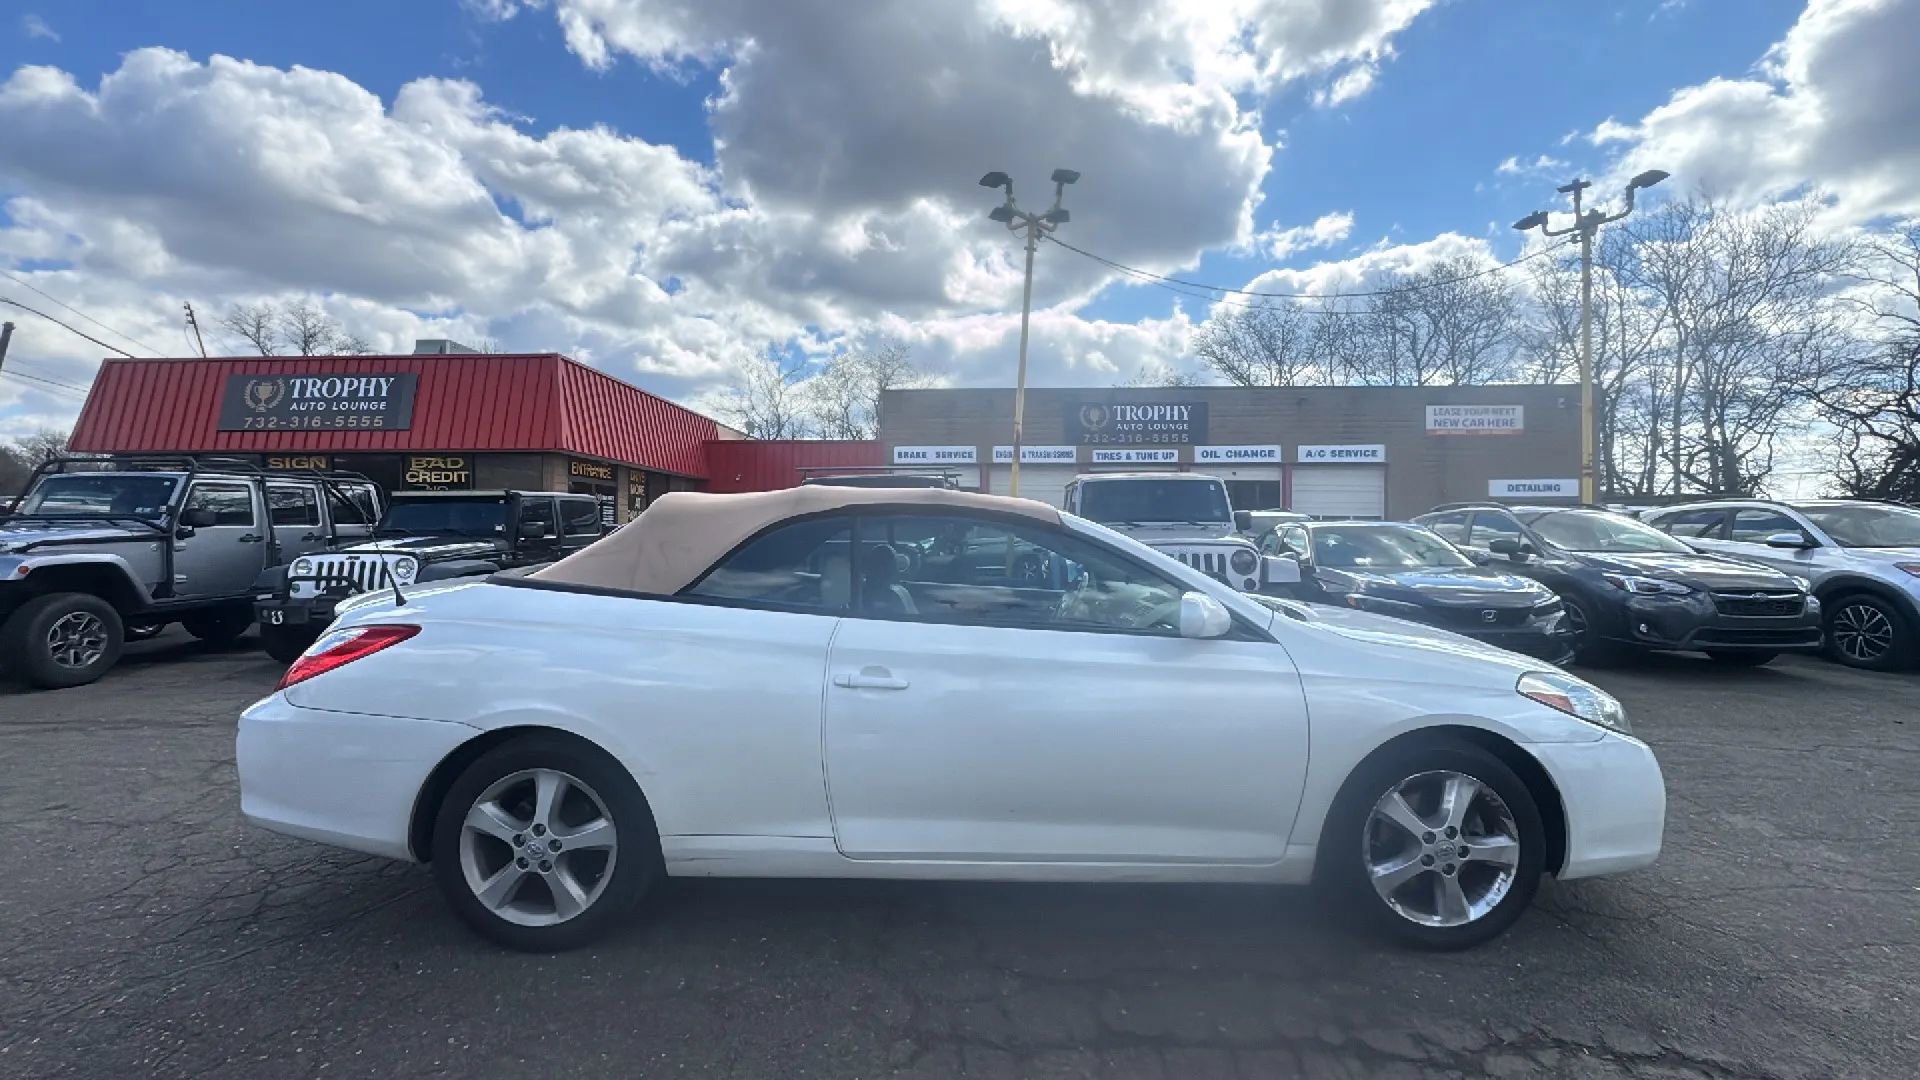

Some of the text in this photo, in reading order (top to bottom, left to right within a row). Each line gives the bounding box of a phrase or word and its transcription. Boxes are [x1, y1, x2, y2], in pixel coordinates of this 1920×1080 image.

[290, 377, 394, 398] TROPHY
[290, 401, 387, 411] AUTO LOUNGE
[1113, 405, 1192, 421] TROPHY
[1433, 407, 1517, 416] LEASE YOUR NEXT
[244, 416, 385, 429] 732-316-5555
[1117, 423, 1189, 431] AUTO LOUNGE
[1433, 418, 1516, 427] NEW CAR HERE
[1083, 433, 1189, 443] 732-316-5555
[897, 451, 974, 459] BRAKE SERVICE
[1095, 452, 1175, 461] TIRES & TUNE UP
[1201, 450, 1275, 459] OIL CHANGE
[1305, 449, 1378, 458] A/C SERVICE
[268, 457, 327, 469] SIGN
[410, 457, 464, 469] BAD
[571, 461, 612, 479] ENTRANCE
[406, 471, 469, 483] CREDIT
[1507, 483, 1561, 492] DETAILING
